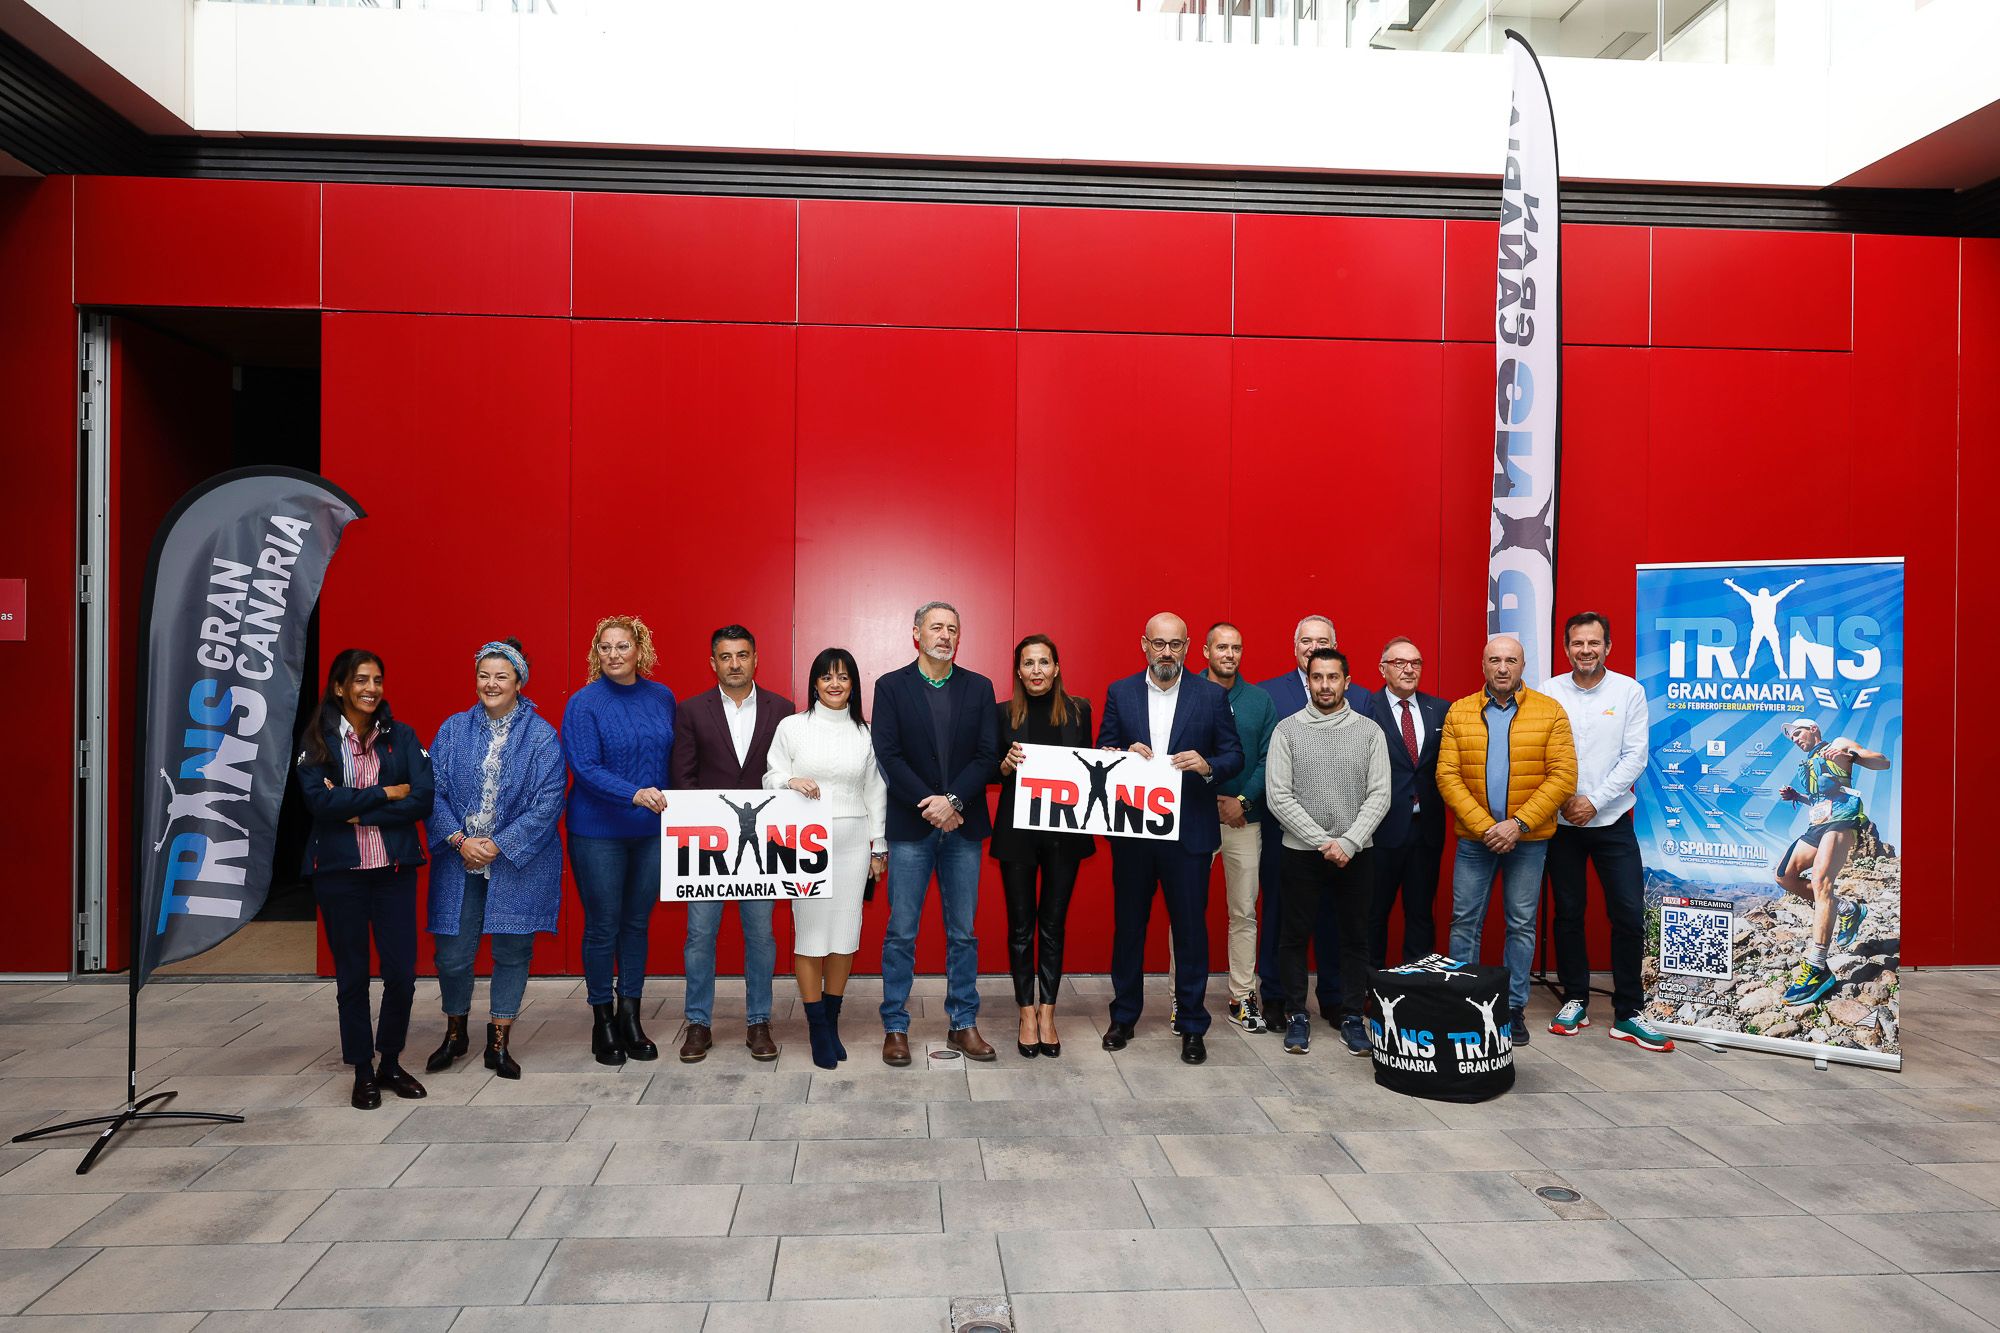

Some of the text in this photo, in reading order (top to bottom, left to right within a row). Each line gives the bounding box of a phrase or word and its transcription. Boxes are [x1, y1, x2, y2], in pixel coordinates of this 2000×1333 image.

[236, 514, 313, 681] CANARIA
[196, 557, 254, 672] GRAN
[1655, 615, 1882, 681] TRANS
[1667, 682, 1718, 700] GRAN
[1720, 683, 1805, 702] CANARIA
[1667, 702, 1687, 710] 22-26
[1787, 704, 1805, 713] 2023
[156, 678, 269, 936] TRANS
[1021, 776, 1175, 836] TRANS
[666, 823, 829, 877] TRANS
[1680, 840, 1768, 860] SPARTAN TRAIL
[1707, 858, 1768, 868] CHAMPIONSHIP
[676, 884, 715, 898] GRAN
[717, 883, 777, 897] CANARIA
[1664, 896, 1732, 909] LIVE STREAMING
[1658, 990, 1728, 1006] transgrancanaria.net
[1389, 1053, 1438, 1073] CANARIA
[1458, 1059, 1490, 1074] GRAN
